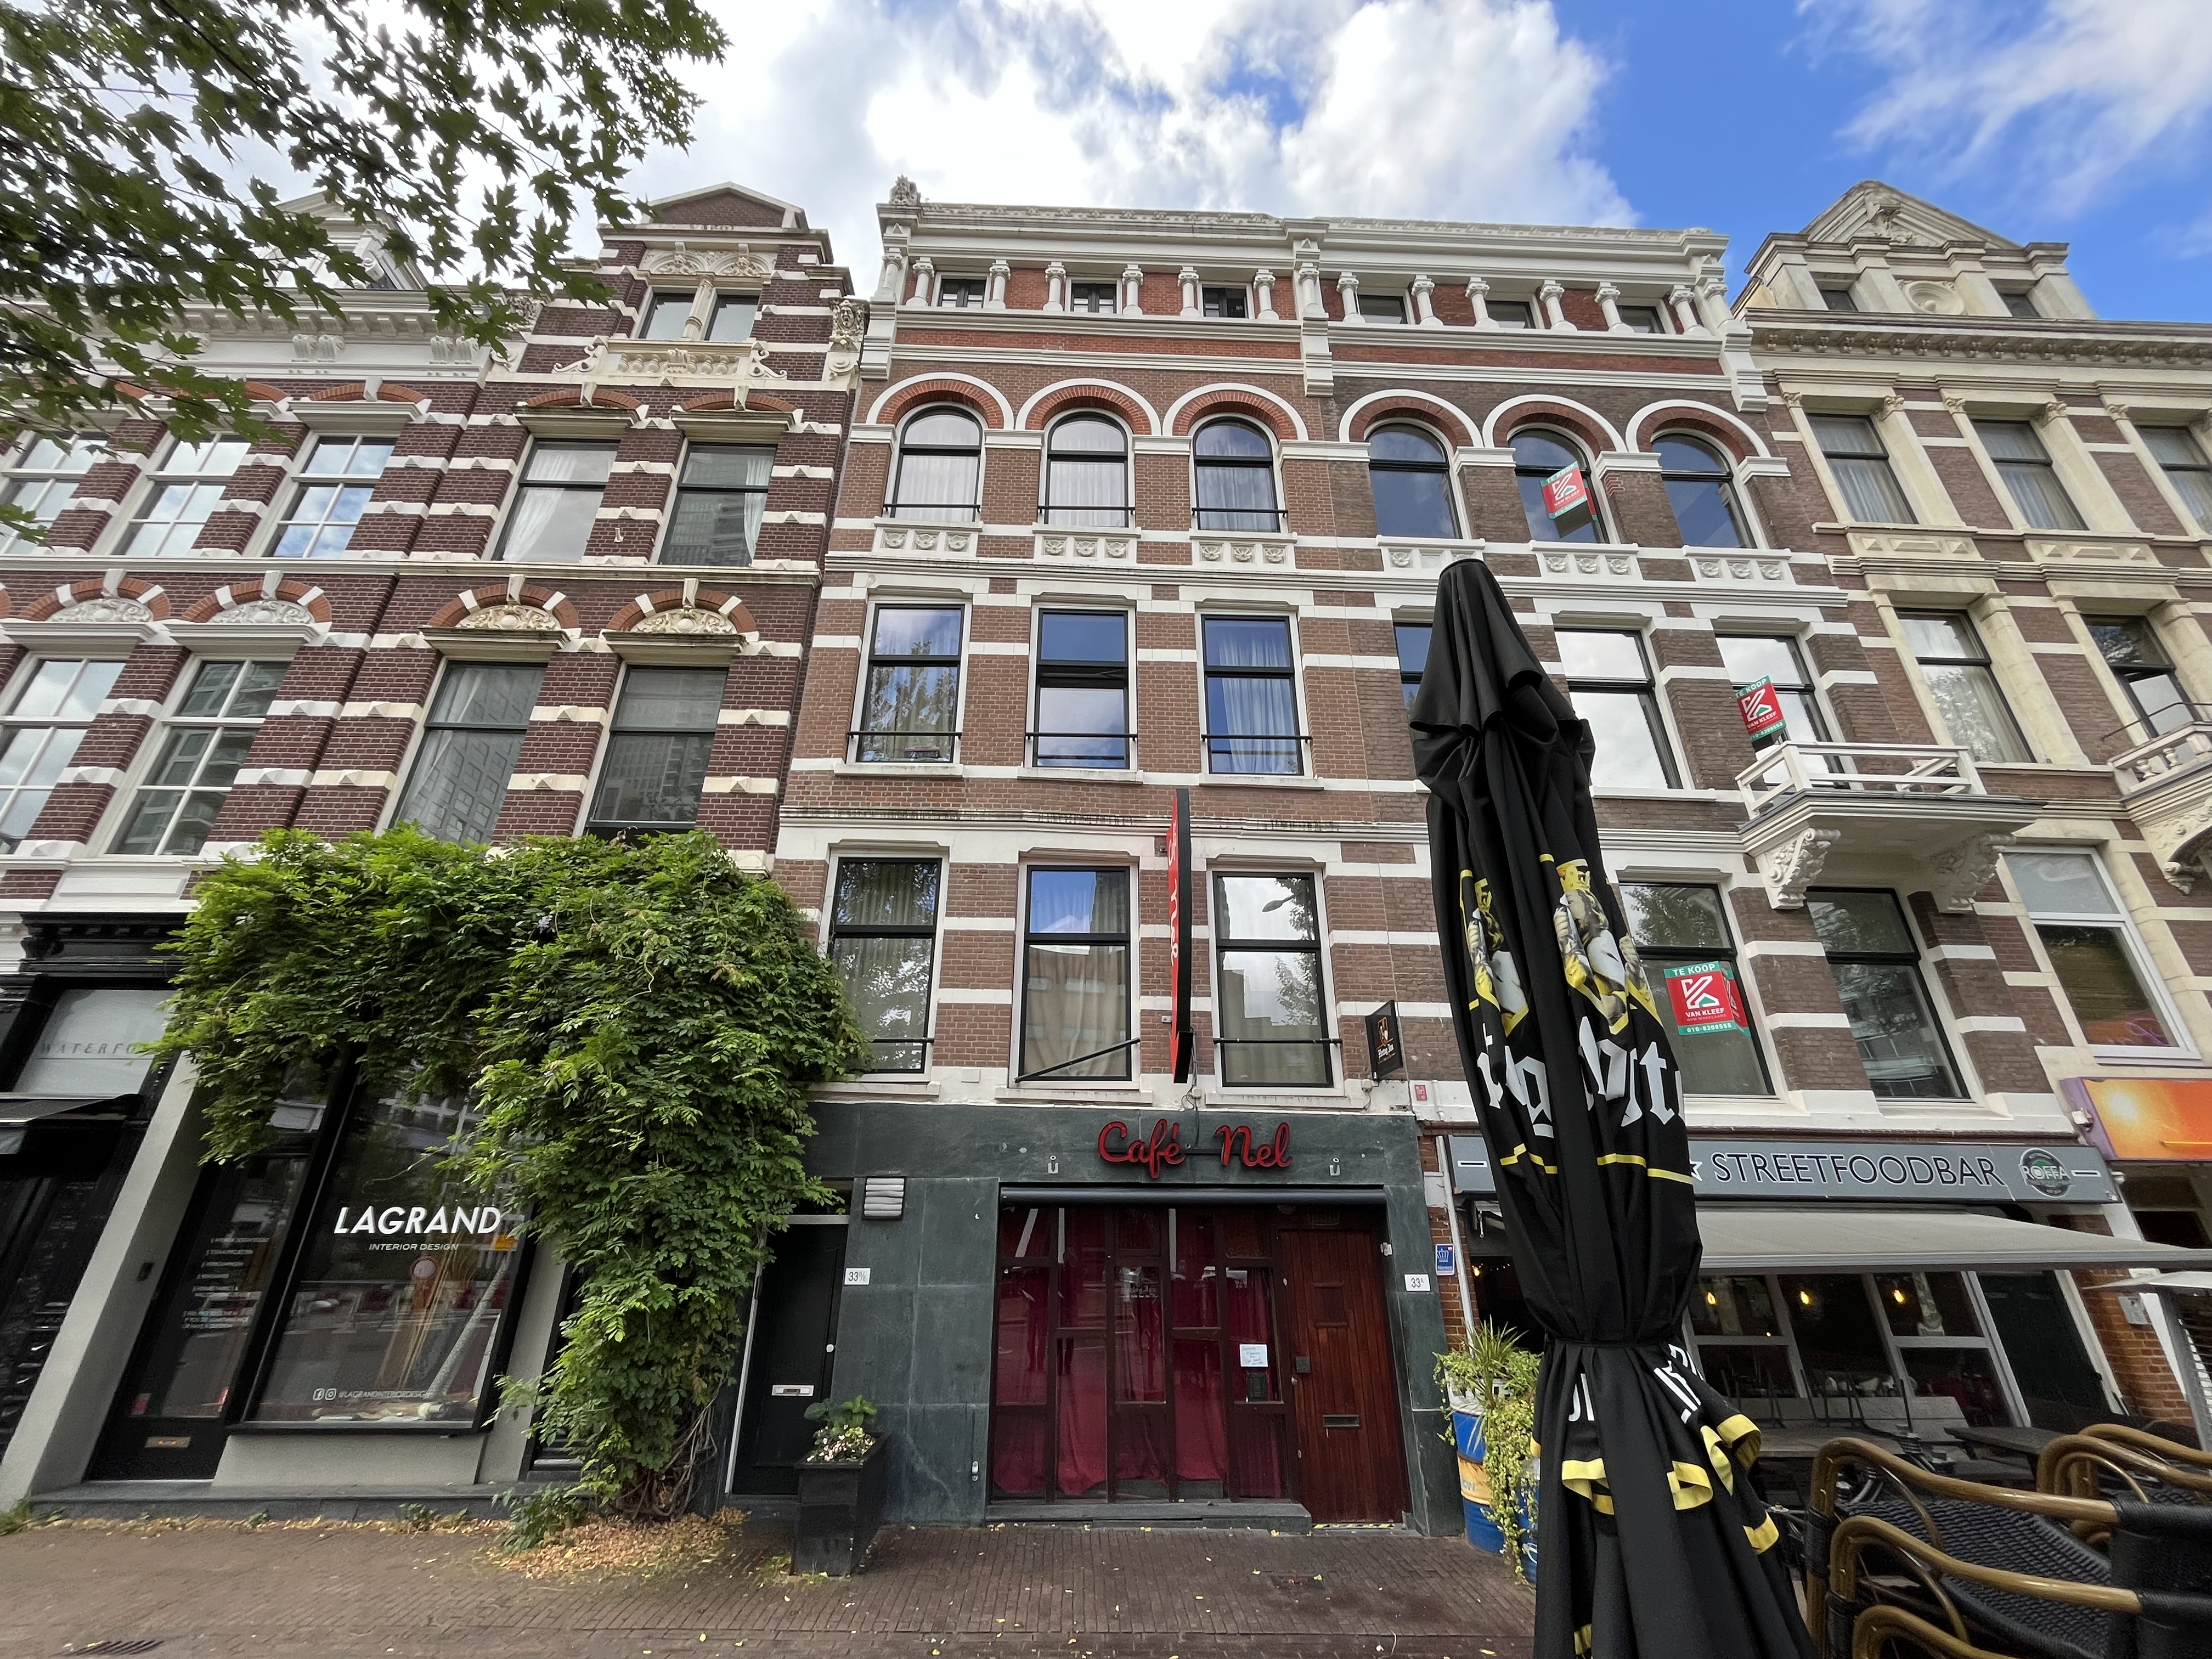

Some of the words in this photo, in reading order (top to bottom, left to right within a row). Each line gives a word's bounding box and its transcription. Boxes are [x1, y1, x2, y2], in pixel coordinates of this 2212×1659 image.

[1745, 678, 1767, 693] KOOP
[1747, 720, 1759, 729] VAN
[1759, 710, 1777, 723] KLEEF
[1688, 963, 1716, 974] KOOP
[1701, 1007, 1725, 1015] KLEEF
[1098, 1118, 1186, 1179] Café
[1214, 1122, 1294, 1167] Nel
[1711, 1152, 2008, 1187] STREETFOODBAR
[2021, 1165, 2072, 1181] ROFFA
[334, 1205, 501, 1235] LAGRAND
